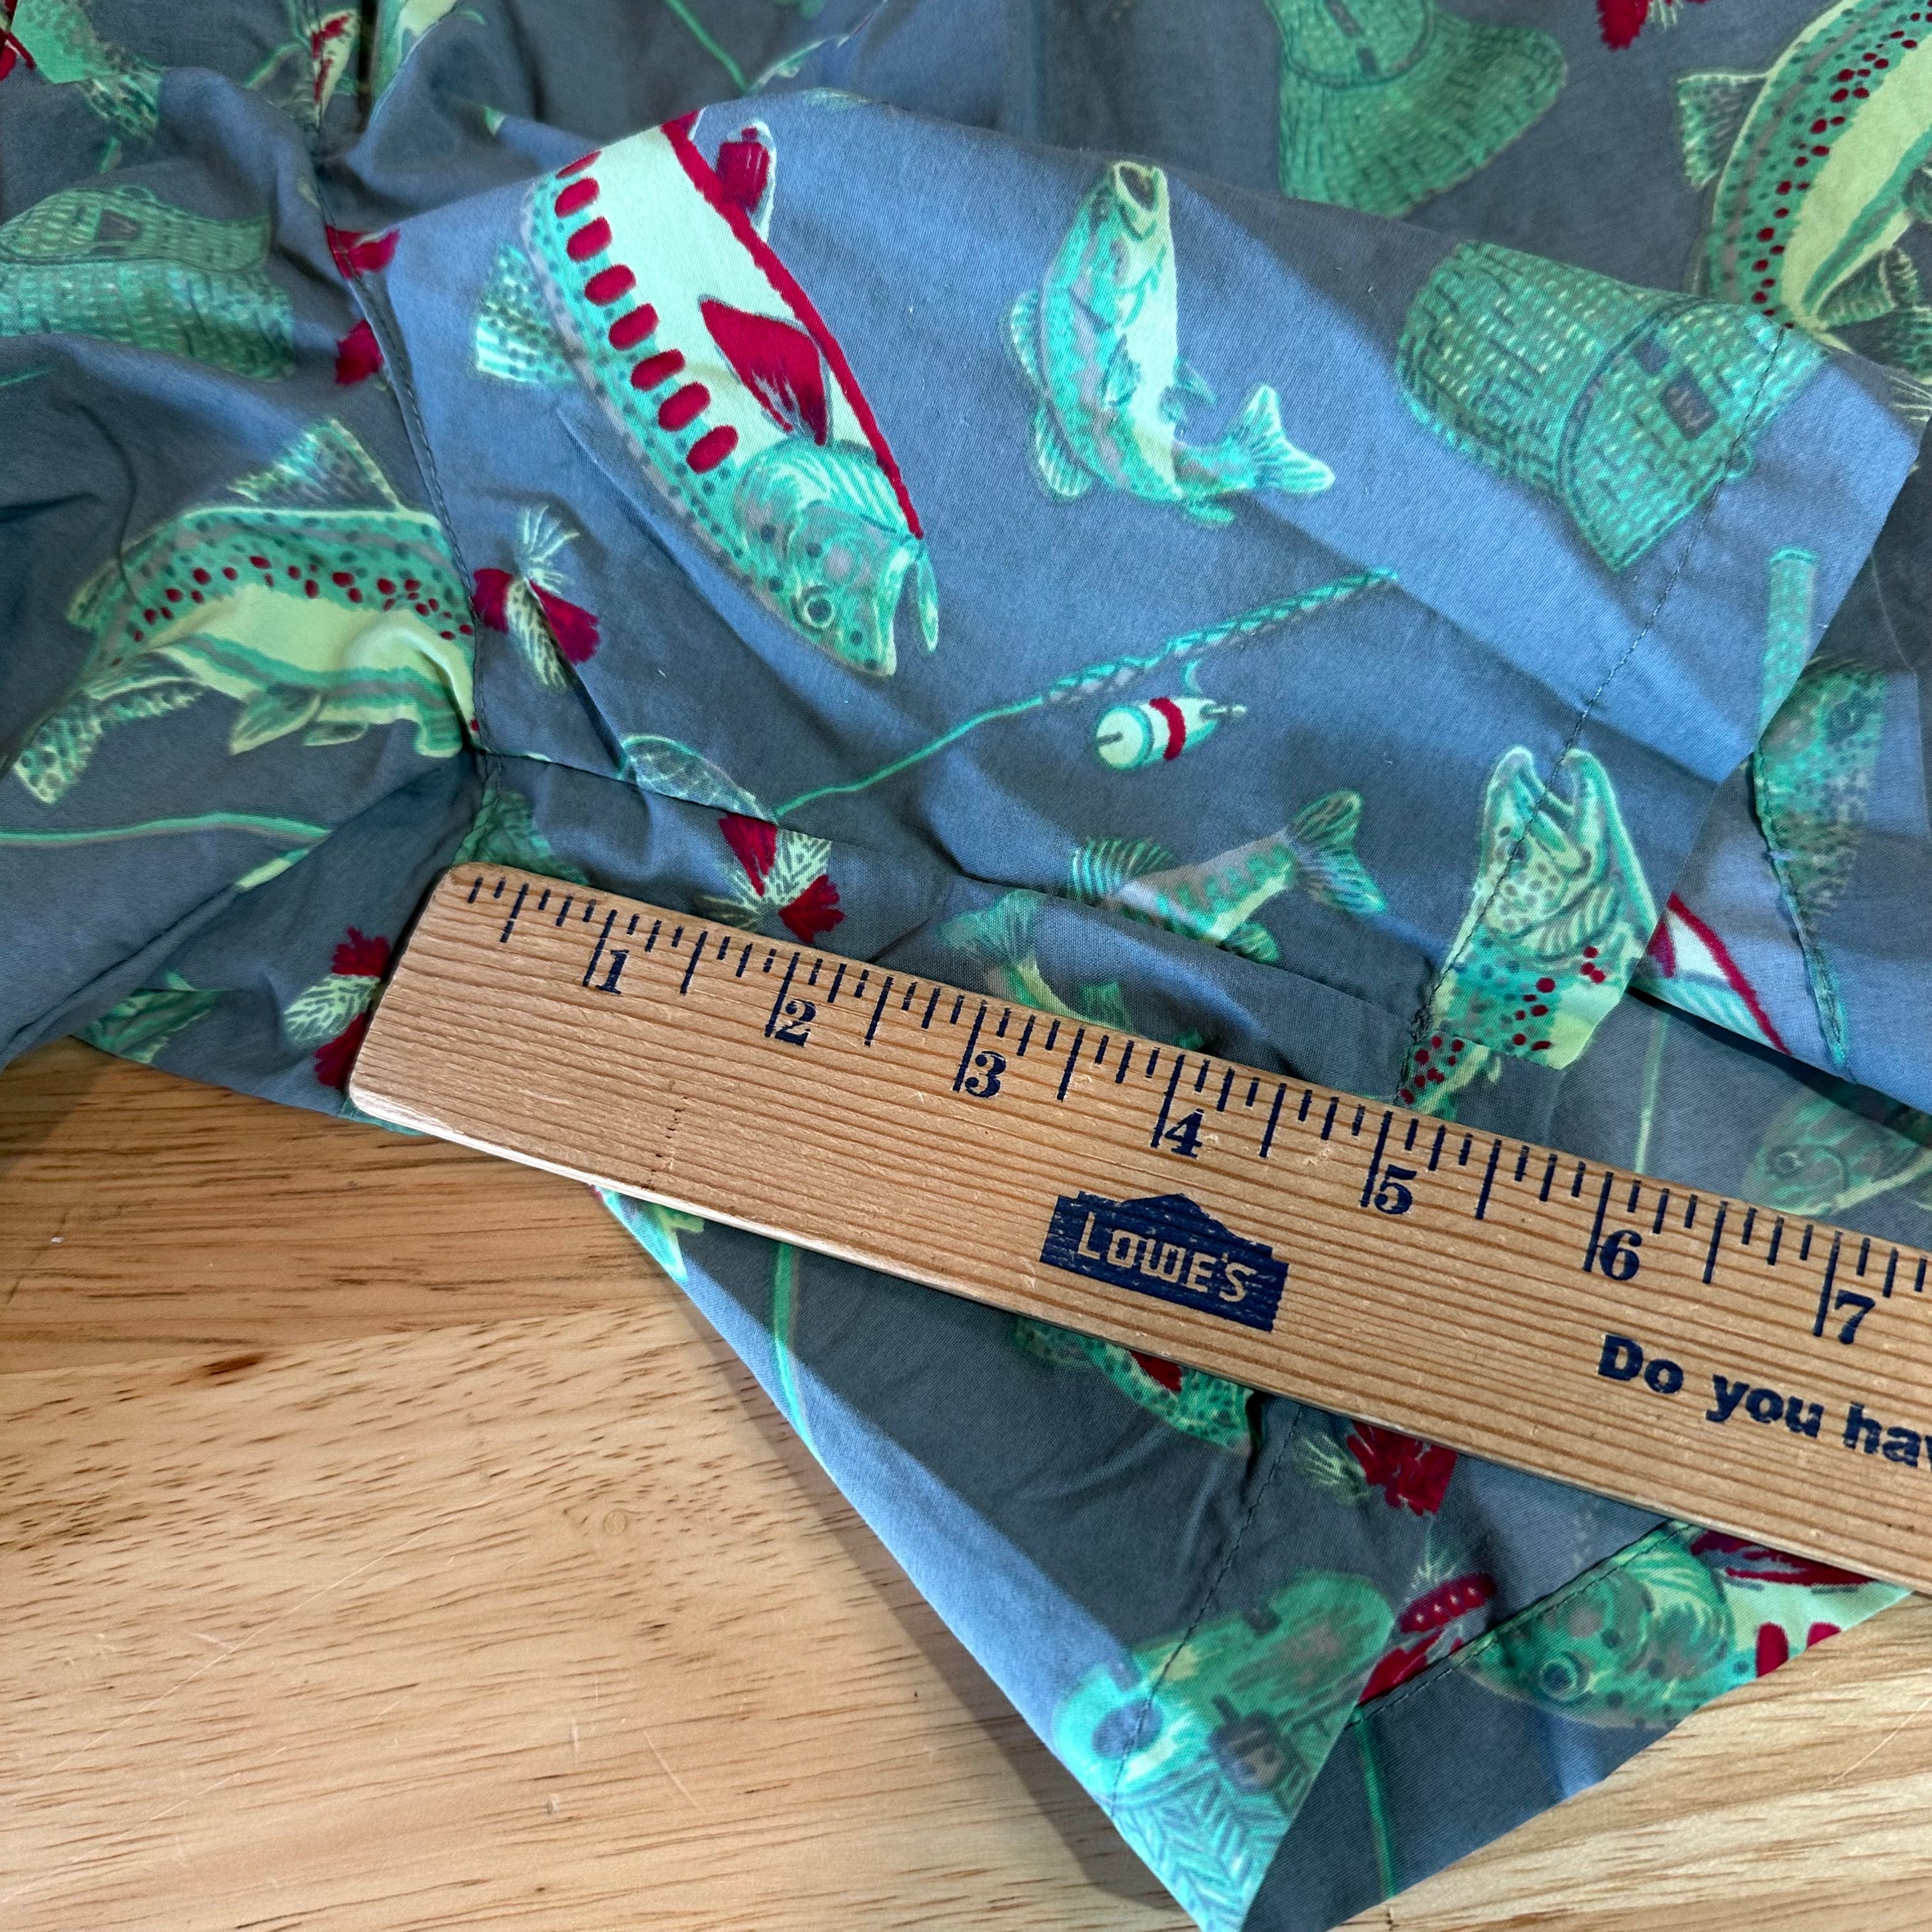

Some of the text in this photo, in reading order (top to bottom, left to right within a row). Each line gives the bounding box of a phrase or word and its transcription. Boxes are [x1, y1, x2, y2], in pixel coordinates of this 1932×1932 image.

[595, 949, 1876, 1345] 1 2 3 4 5 6 7
[1078, 1211, 1257, 1303] LOWE'S
[1597, 1332, 1932, 1471] Do you ha
